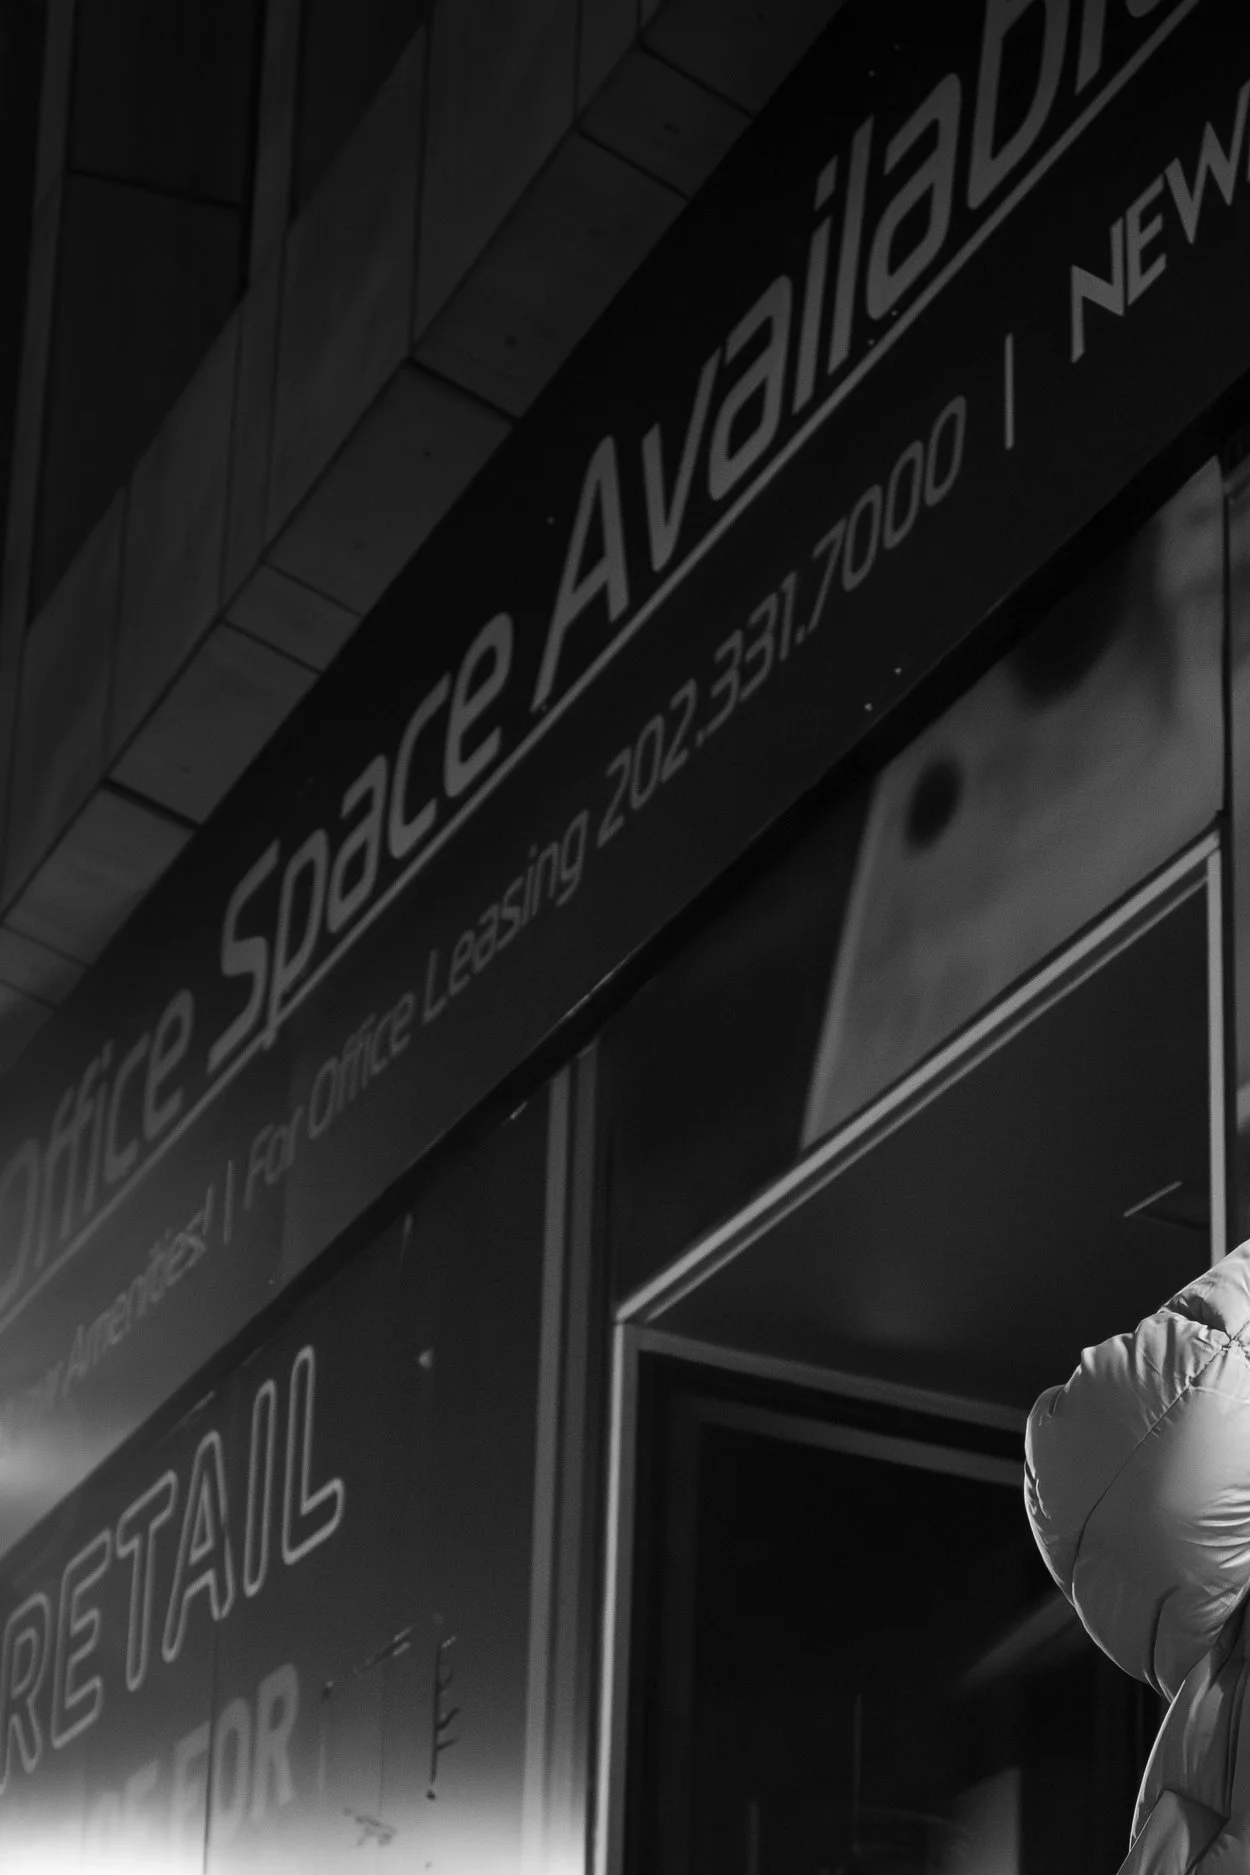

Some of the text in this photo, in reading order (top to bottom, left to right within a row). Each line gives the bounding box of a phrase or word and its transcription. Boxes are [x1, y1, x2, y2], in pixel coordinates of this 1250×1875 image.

[207, 611, 514, 1074] Space
[530, 0, 1168, 714] Availab
[244, 1104, 303, 1208] For
[309, 991, 414, 1139] Office
[423, 810, 590, 1025] Leasing
[597, 395, 966, 848] 202.331.7000
[0, 1346, 345, 1795] RETAIL
